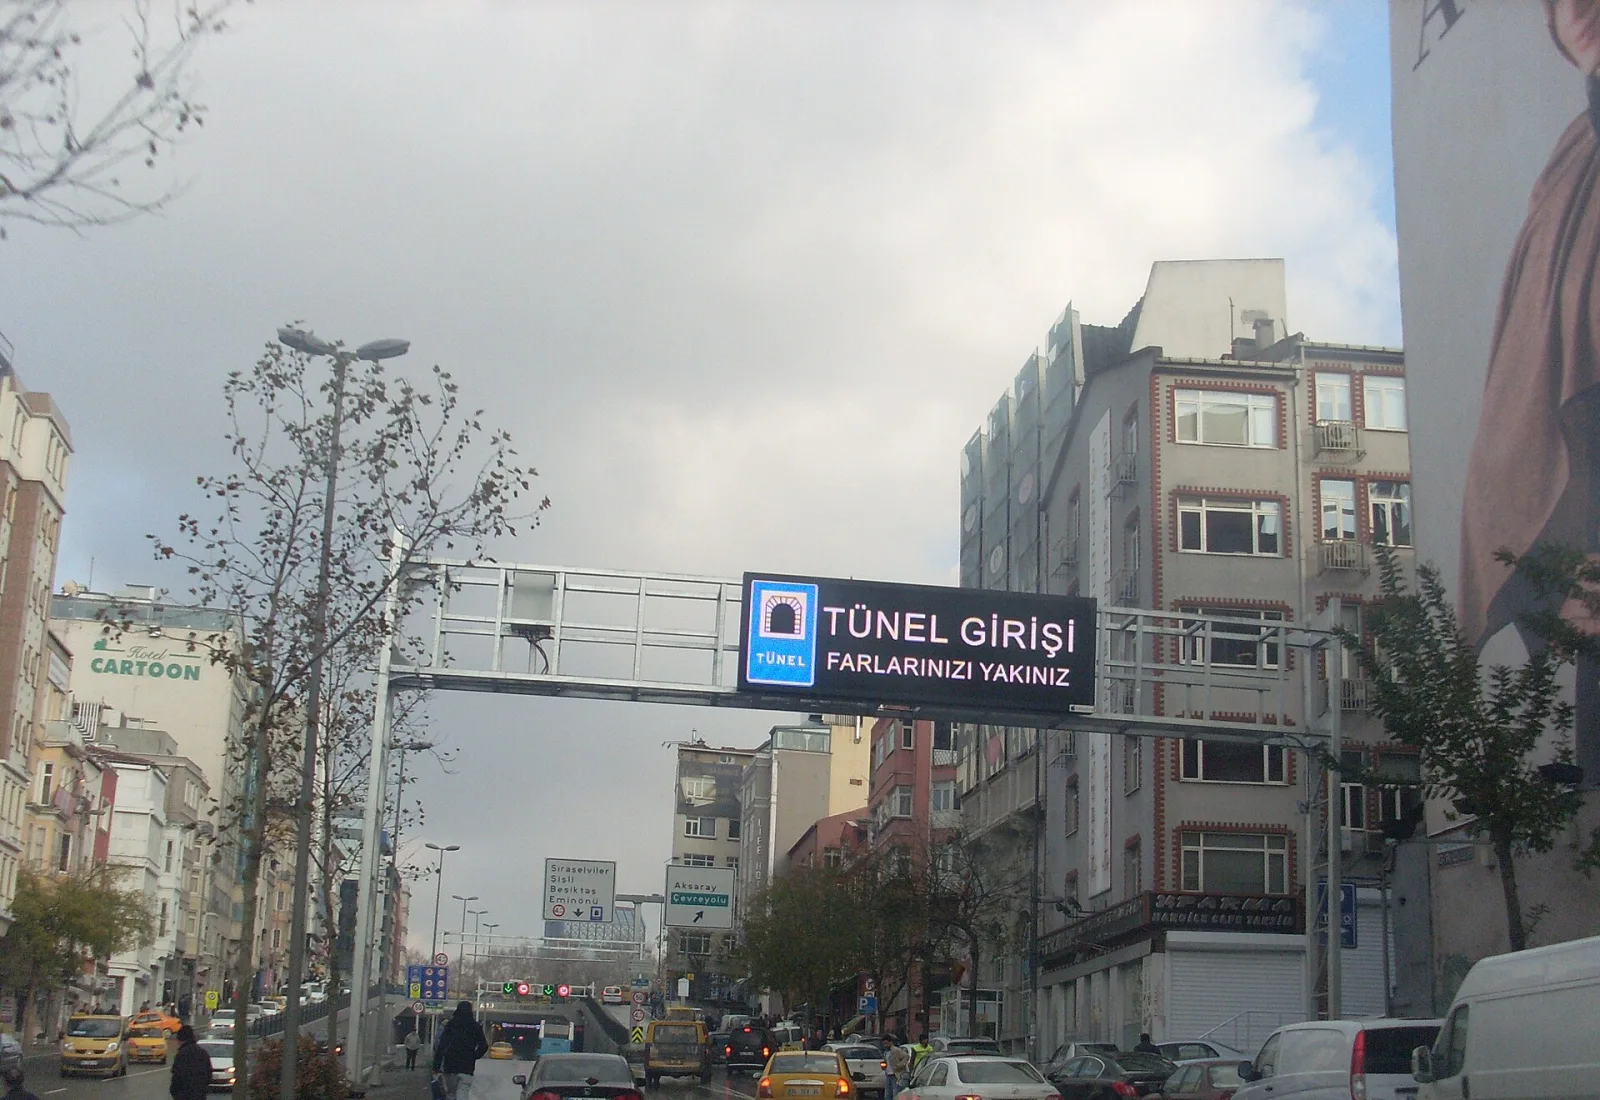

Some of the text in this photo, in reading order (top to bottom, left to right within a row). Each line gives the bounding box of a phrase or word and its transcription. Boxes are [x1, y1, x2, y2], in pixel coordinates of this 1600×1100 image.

[823, 604, 1075, 659] TÜNEL GİRİŞİ
[127, 645, 168, 660] Hotel
[756, 650, 806, 668] TÜNEL
[90, 657, 200, 680] CARTOON
[827, 651, 1070, 687] FARLARINIZI YAKINIZ
[674, 881, 717, 893] Aksaray
[672, 893, 727, 905] Çevreyolu
